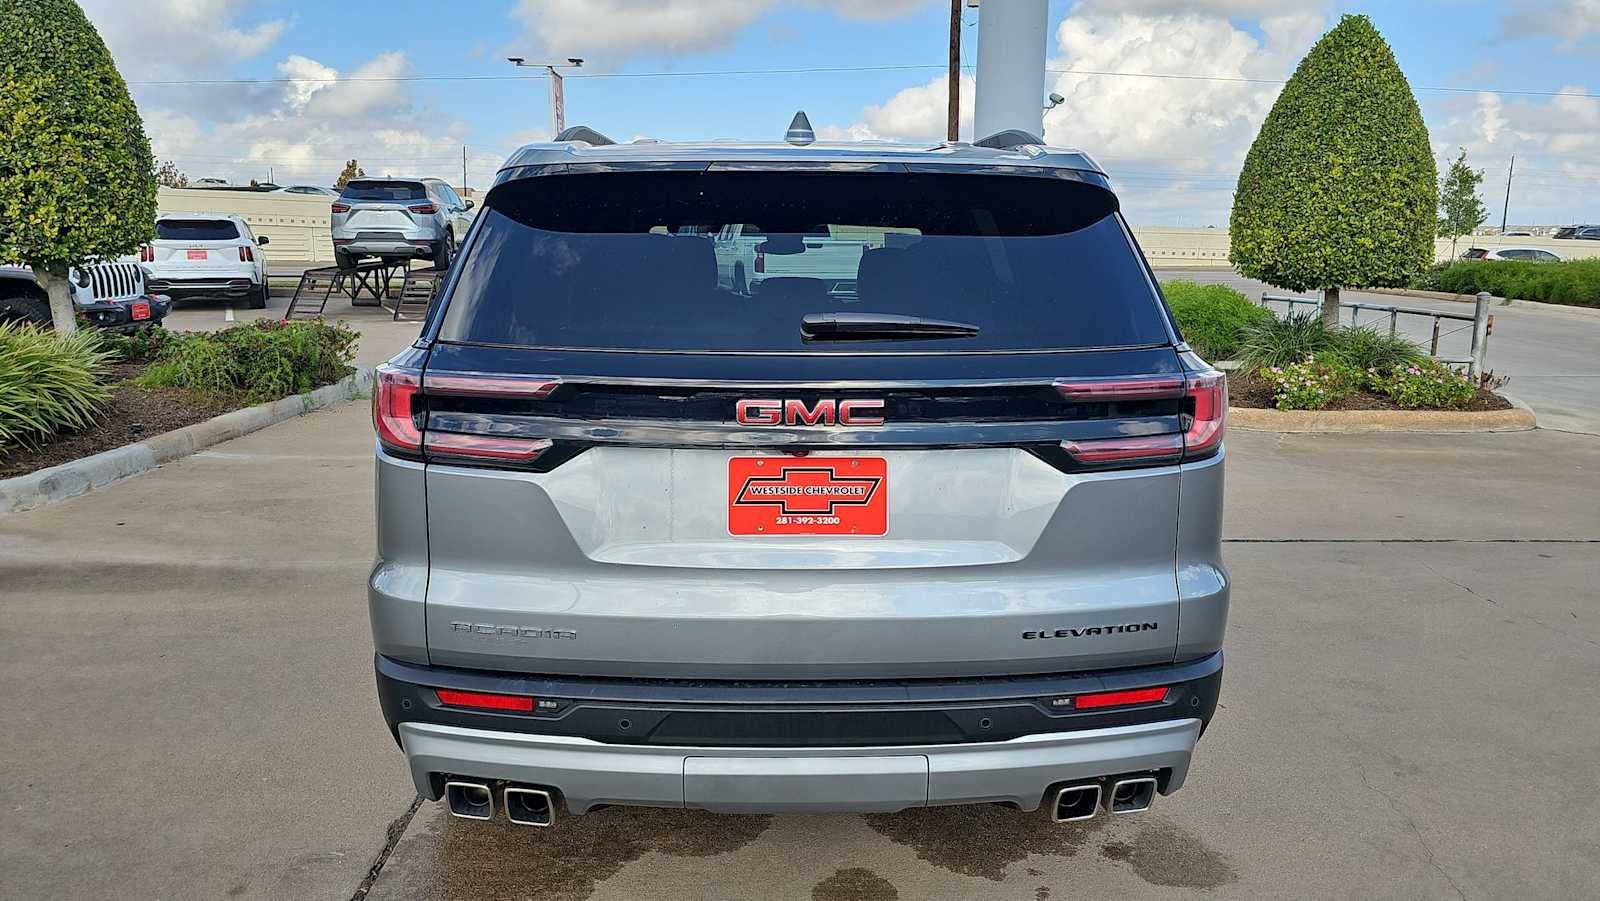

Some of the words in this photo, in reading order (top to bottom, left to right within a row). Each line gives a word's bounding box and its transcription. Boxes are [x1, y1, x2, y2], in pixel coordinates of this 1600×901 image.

[736, 399, 885, 426] GMC
[750, 486, 803, 495] WESTSIDE
[805, 486, 865, 495] CHEVROLET
[776, 516, 840, 525] 281-392-3200
[451, 621, 577, 640] ACADIA
[1022, 622, 1158, 640] ELEVATION
